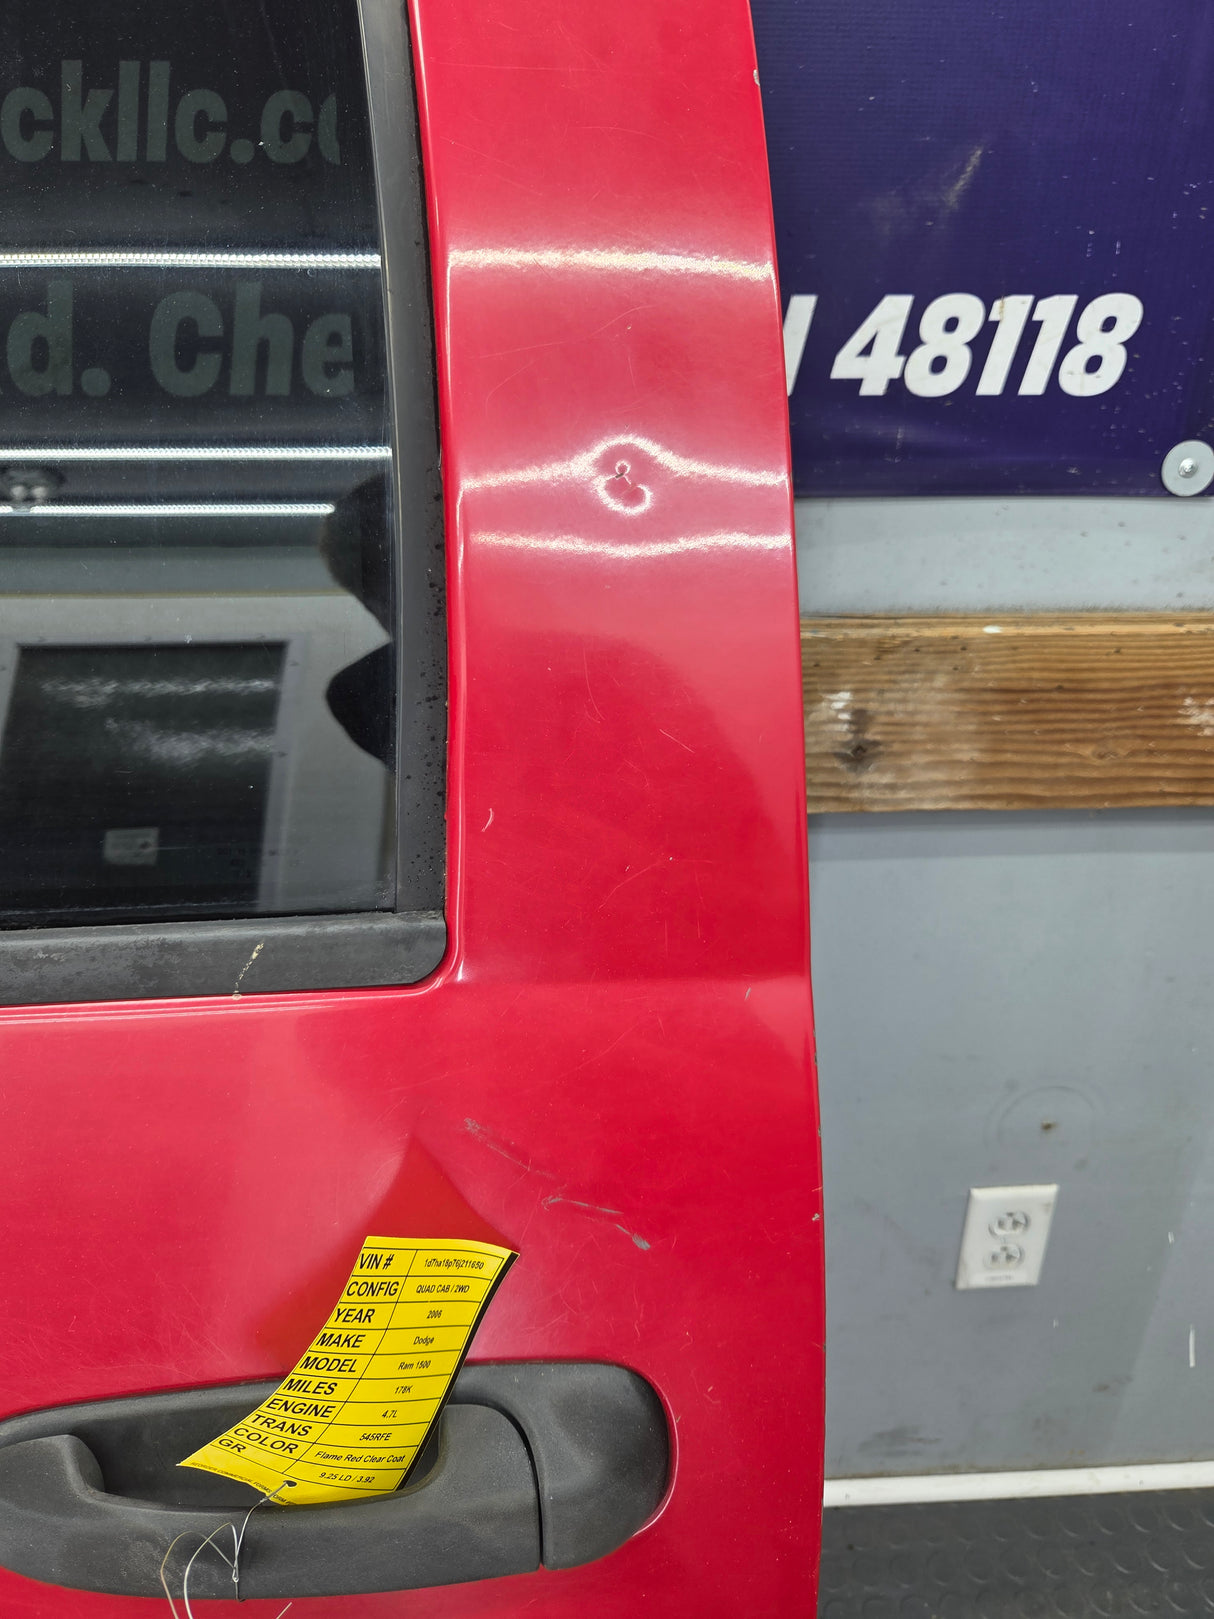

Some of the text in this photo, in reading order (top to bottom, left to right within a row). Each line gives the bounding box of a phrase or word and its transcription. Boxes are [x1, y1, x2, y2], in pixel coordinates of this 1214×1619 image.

[830, 292, 1144, 398] 48118
[358, 1254, 394, 1270] VIN #
[346, 1281, 399, 1297] CONFIG
[416, 1285, 435, 1293] QUAD
[436, 1285, 451, 1293] CAB
[454, 1285, 470, 1293] 2WD
[334, 1308, 375, 1323] YEAR
[427, 1310, 442, 1319] 2006
[315, 1333, 365, 1348] MAKE
[413, 1336, 434, 1345] Dodge
[300, 1356, 357, 1373] MODEL
[398, 1360, 431, 1370] Ram 1500
[283, 1378, 338, 1396] MILES
[394, 1385, 413, 1394] 178K
[266, 1398, 336, 1418] ENGINE
[381, 1409, 398, 1419] 4.7L
[251, 1414, 312, 1436] TRANS
[233, 1428, 299, 1454] COLOR
[359, 1432, 392, 1441] 545RFE
[218, 1439, 247, 1453] GR
[315, 1450, 405, 1463] Flame Red Clear Coat
[319, 1472, 338, 1480] 9.25
[339, 1474, 352, 1482] LD
